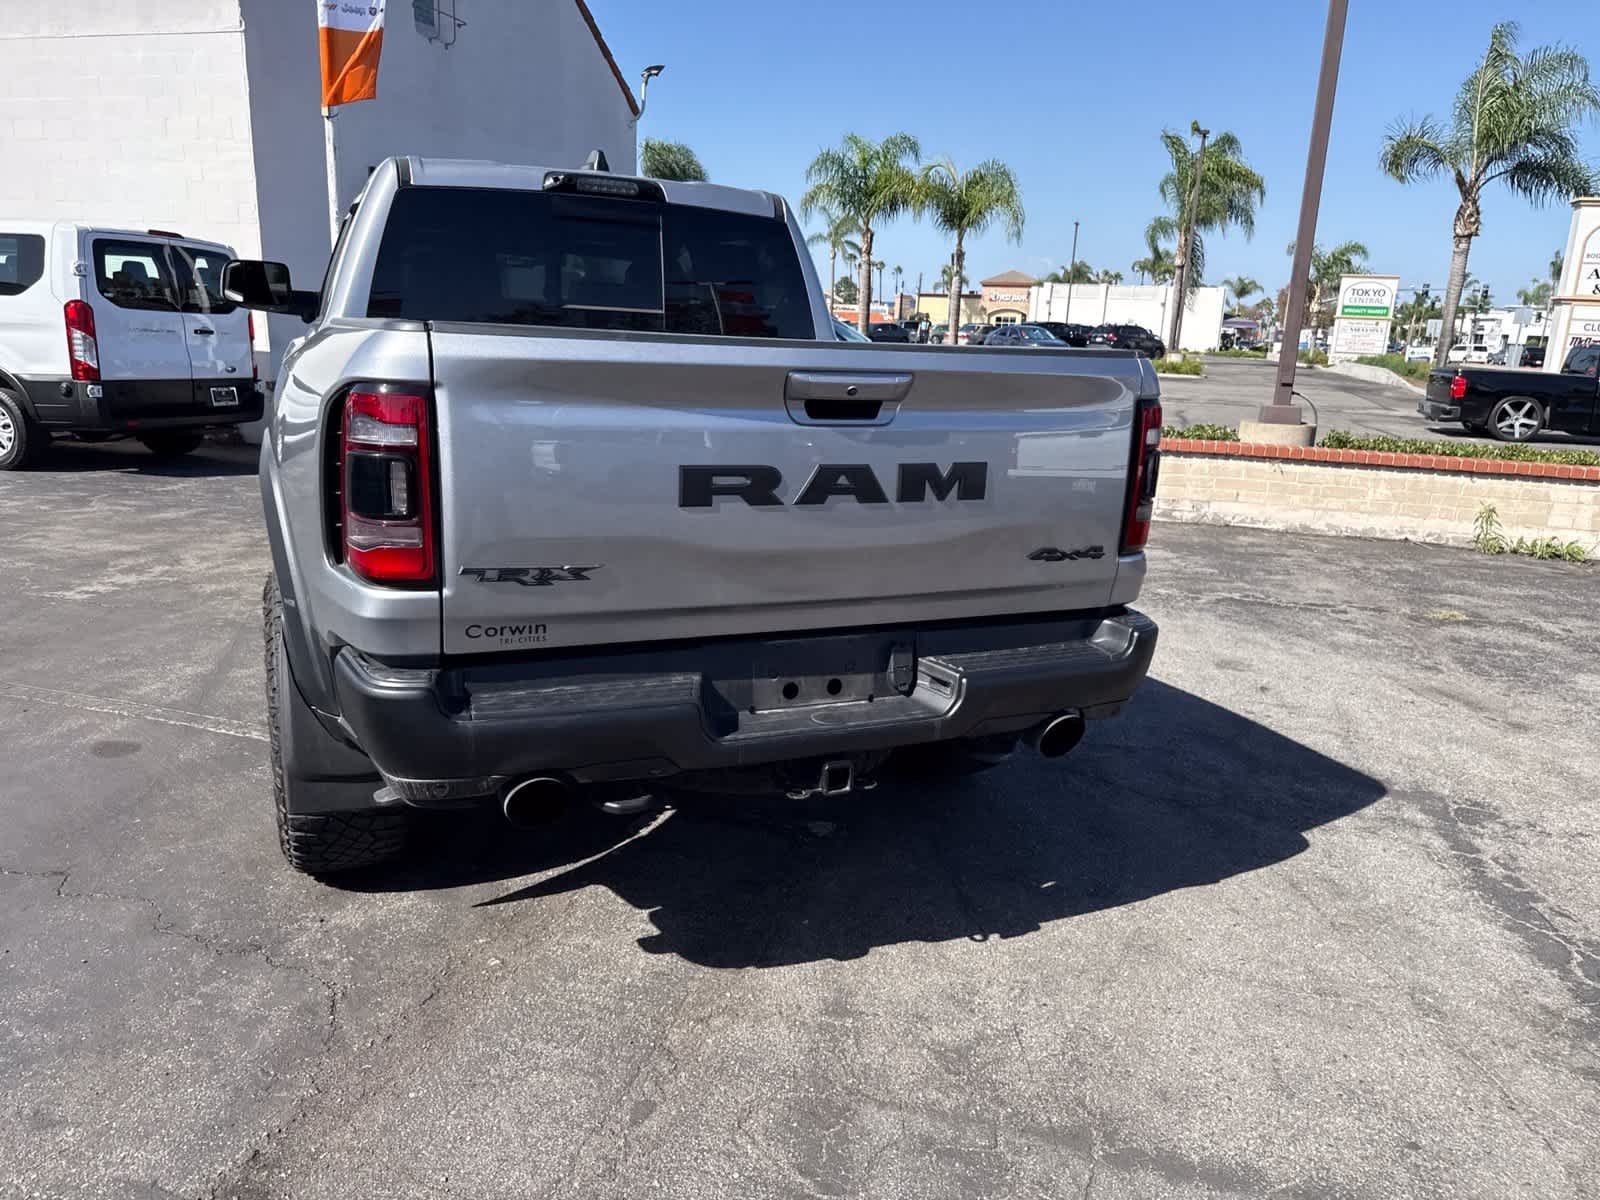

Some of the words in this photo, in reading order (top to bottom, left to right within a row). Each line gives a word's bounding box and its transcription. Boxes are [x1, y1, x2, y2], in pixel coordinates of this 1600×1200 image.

[1351, 288, 1386, 297] TOKYO
[679, 461, 988, 508] RAM
[465, 624, 547, 639] Corwin
[500, 636, 547, 644] TRI-CITIES
